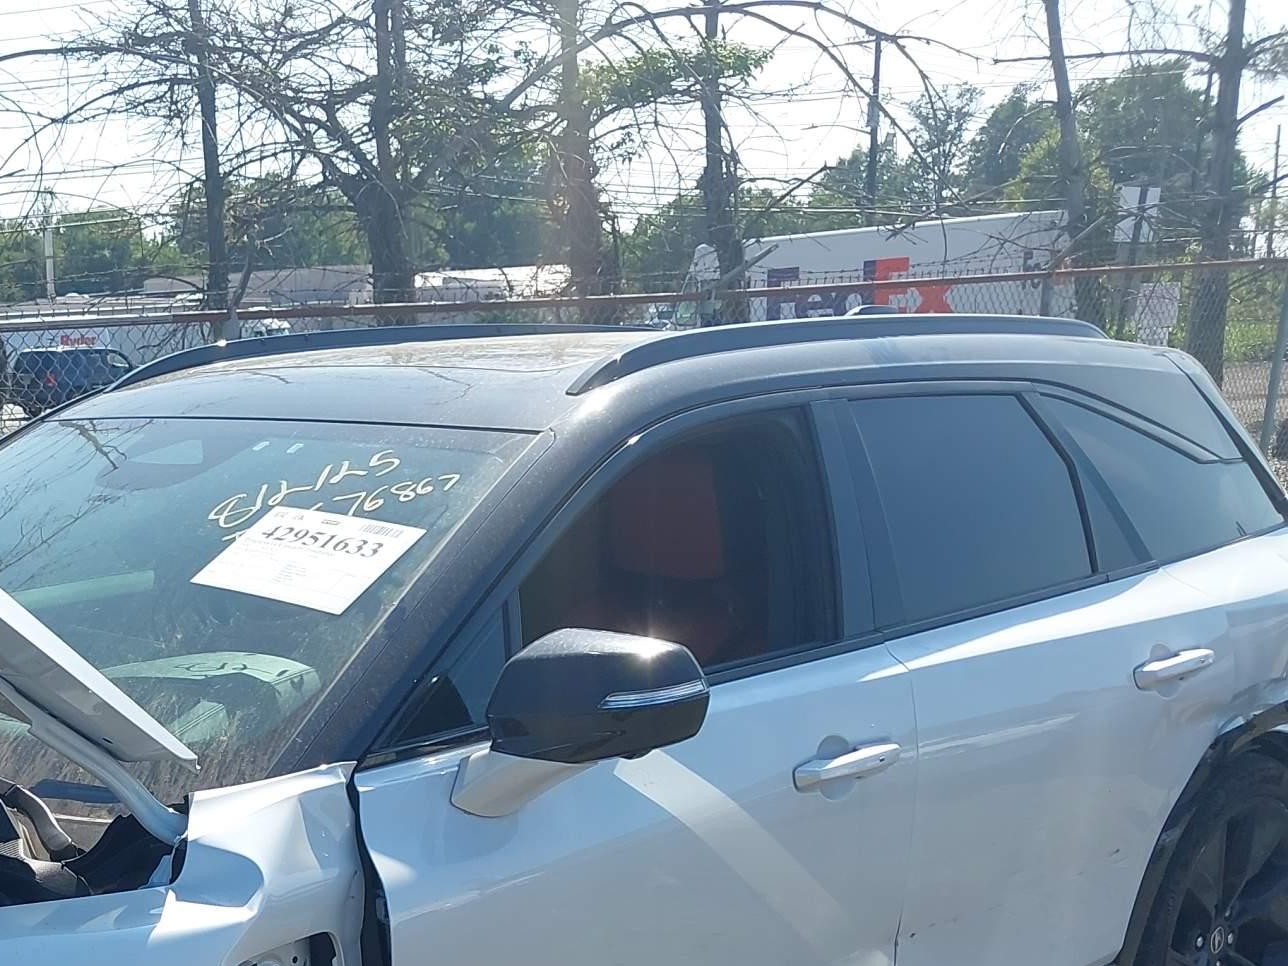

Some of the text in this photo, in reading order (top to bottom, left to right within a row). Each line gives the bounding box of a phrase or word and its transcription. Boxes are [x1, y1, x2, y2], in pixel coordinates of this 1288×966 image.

[766, 256, 955, 323] FedEx
[61, 335, 97, 347] Ryder
[261, 525, 384, 558] 42951633
